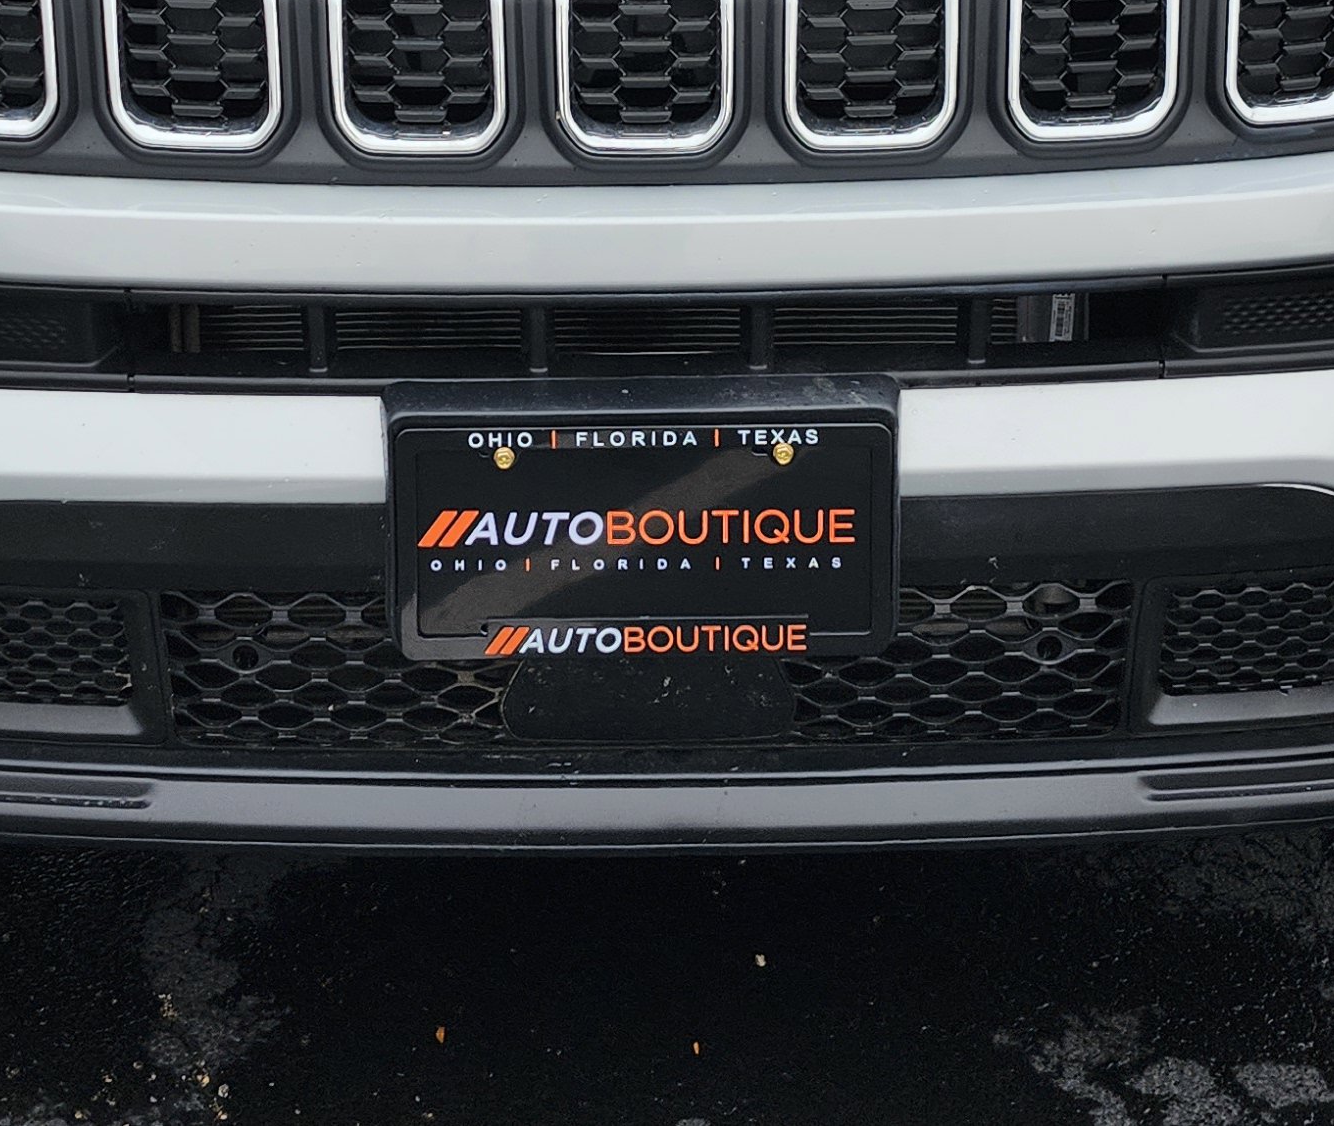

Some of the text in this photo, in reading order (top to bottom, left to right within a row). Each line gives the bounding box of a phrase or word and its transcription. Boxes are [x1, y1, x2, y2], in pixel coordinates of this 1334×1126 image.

[468, 428, 819, 449] OHIO FLORIDA TEXAS
[464, 508, 856, 546] AUTOBOUTIQUE
[430, 556, 842, 572] OHIO FLORIDA TEXAS
[520, 623, 808, 655] AUTOBOUTIQUE
